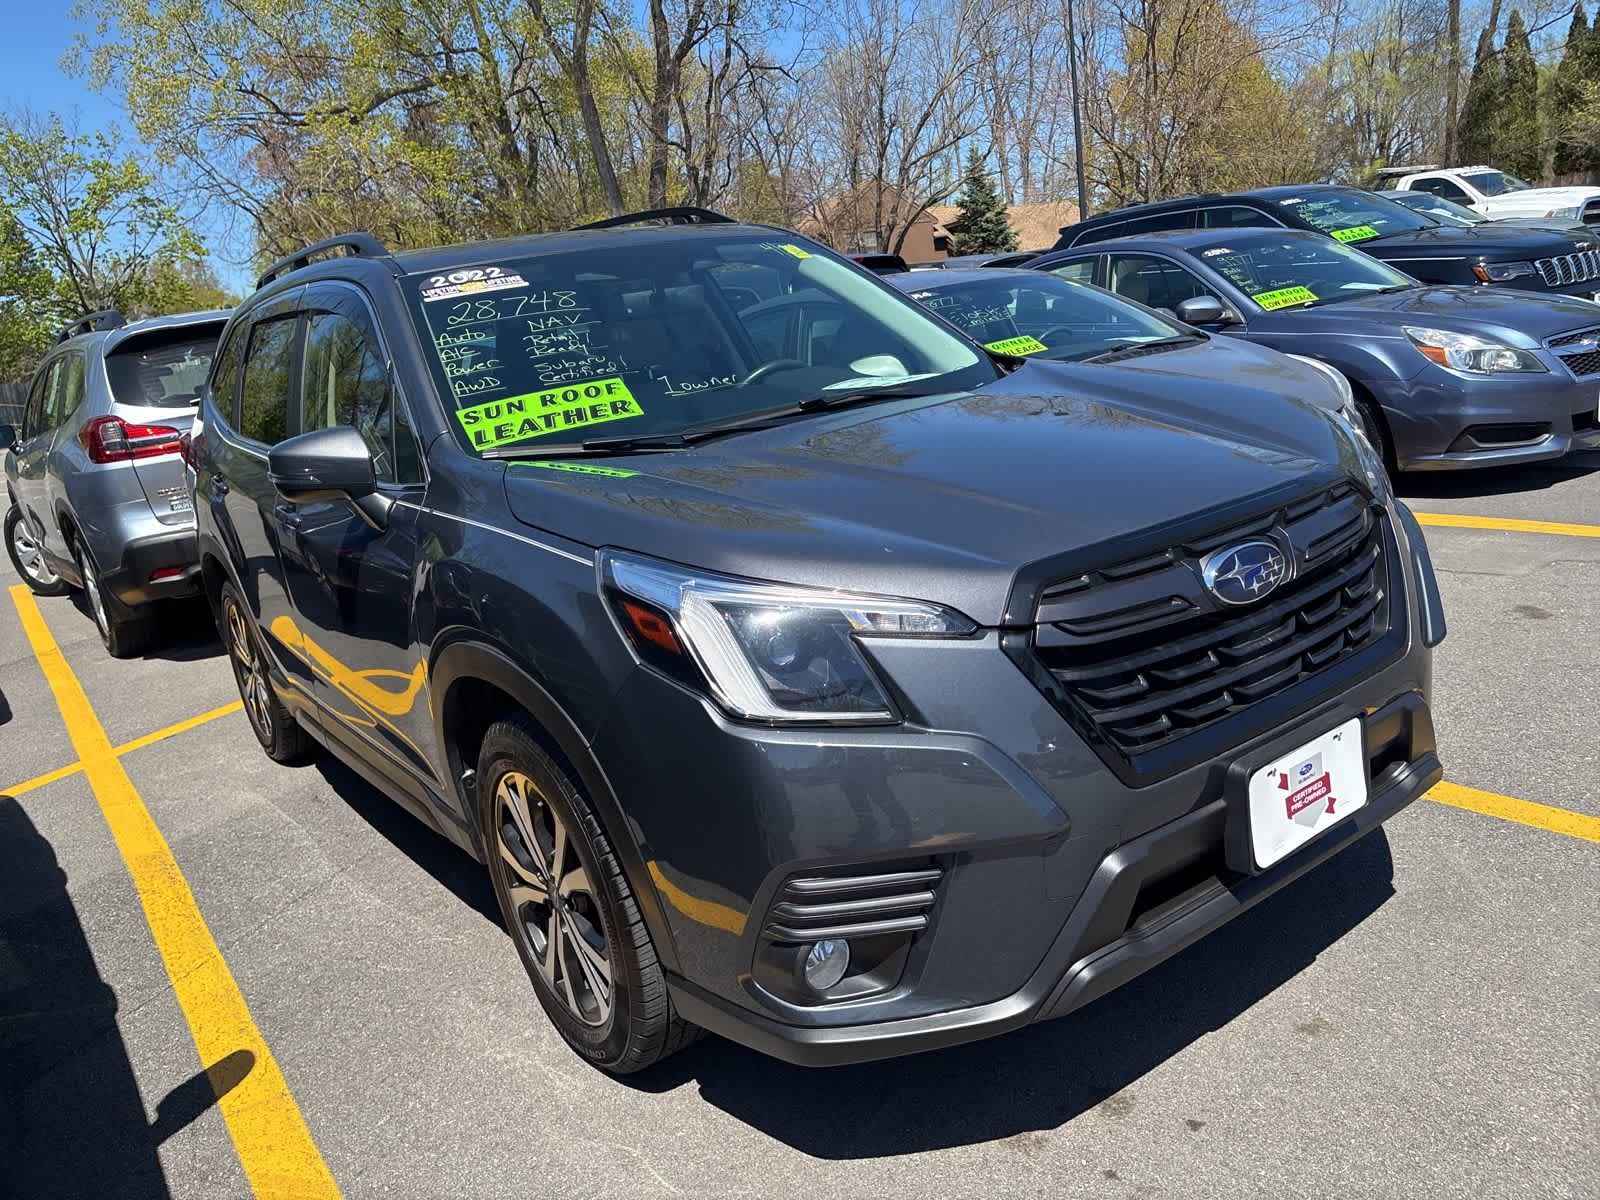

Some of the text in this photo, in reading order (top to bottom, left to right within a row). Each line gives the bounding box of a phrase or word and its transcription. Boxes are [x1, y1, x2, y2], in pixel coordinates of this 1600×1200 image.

[430, 267, 505, 288] 2022
[447, 290, 577, 325] 28,748
[1263, 300, 1281, 309] LOW
[527, 313, 581, 332] NAV
[433, 328, 486, 347] Auto
[446, 359, 500, 378] Power
[533, 355, 606, 372] Subaru
[463, 382, 623, 426] SUN ROOF
[473, 400, 633, 447] LEATHER
[1292, 780, 1323, 803] CERTIFIED
